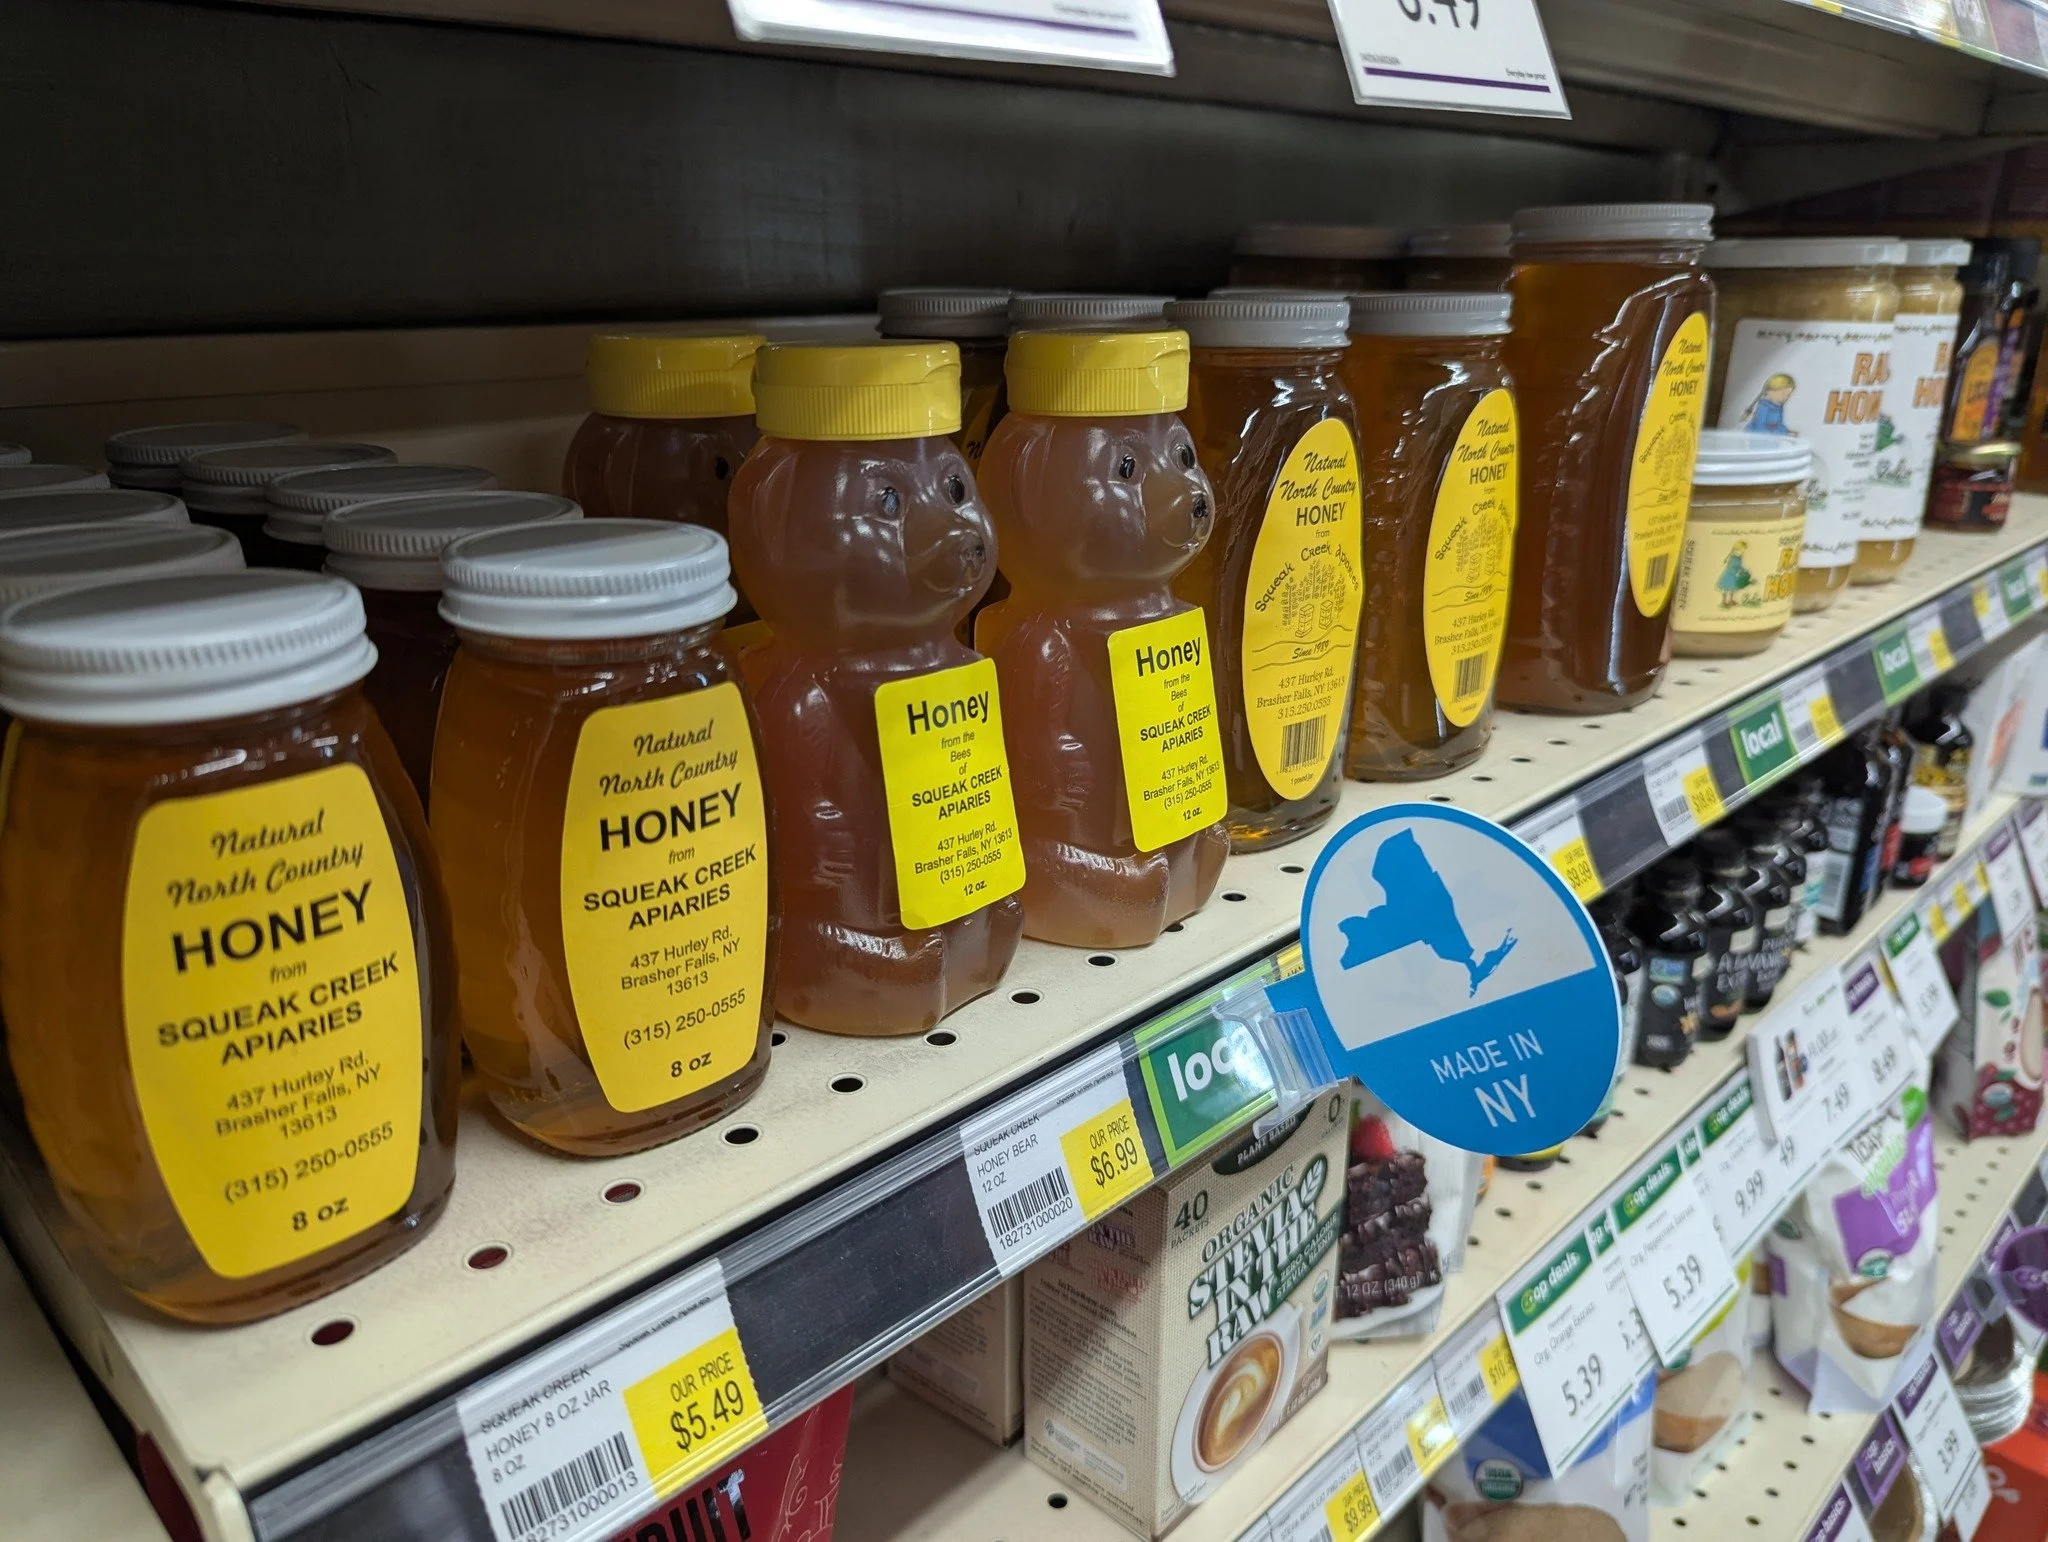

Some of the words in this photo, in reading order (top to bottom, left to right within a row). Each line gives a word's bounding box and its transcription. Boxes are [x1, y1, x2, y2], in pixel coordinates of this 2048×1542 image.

[1669, 380, 1699, 397] HONEY
[1476, 418, 1510, 438] Natural
[1304, 452, 1347, 473] Natural
[1457, 443, 1486, 463] North
[1279, 478, 1319, 502] North
[1322, 476, 1356, 501] Country
[1469, 462, 1508, 485] HONEY
[1296, 502, 1346, 527] HONEY
[1434, 516, 1467, 561] Squeak
[1472, 497, 1496, 516] Creek
[1316, 529, 1330, 538] from
[1255, 561, 1295, 612] Squeak
[1301, 540, 1332, 562] Creek
[1136, 637, 1201, 677] Honey
[1292, 648, 1312, 659] Since
[1434, 632, 1462, 646] Brasher
[1881, 636, 1910, 680] local
[1163, 677, 1180, 689] from
[1181, 672, 1191, 684] the
[1171, 688, 1188, 701] Bees
[1256, 694, 1292, 708] Brasher
[1294, 688, 1312, 700] Falls,
[1314, 683, 1326, 696] NY
[1279, 676, 1296, 689] 437
[1298, 670, 1323, 684] Hurley
[906, 690, 989, 735] Honey
[1140, 716, 1185, 741] SQUEAK
[1187, 704, 1212, 726] CREEK
[1178, 702, 1185, 713] of
[633, 719, 713, 757] Natural
[941, 737, 961, 749] from
[962, 730, 975, 743] the
[1162, 726, 1204, 753] APIARIES
[1740, 713, 1783, 760] local
[599, 770, 665, 797] North
[670, 749, 739, 789] Country
[950, 748, 971, 763] Bees
[958, 762, 967, 775] of
[1161, 768, 1176, 781] 437
[1178, 759, 1198, 777] Hurley
[1199, 754, 1209, 768] Rd.
[912, 779, 968, 808] SQUEAK
[970, 764, 1003, 790] CREEK
[1143, 783, 1175, 801] Brasher
[1177, 773, 1195, 790] Falls,
[1196, 768, 1206, 782] NY
[1163, 792, 1184, 810] (315)
[600, 783, 743, 852] HONEY
[938, 790, 991, 820] APIARIES
[1183, 809, 1191, 821] 12
[1192, 805, 1202, 817] oz.
[210, 808, 326, 858] Natural
[937, 837, 954, 851] 437
[957, 827, 984, 847] Hurley
[984, 820, 997, 835] Rd.
[668, 845, 695, 866] from
[915, 854, 954, 875] Brasher
[956, 843, 979, 862] Falls,
[980, 837, 992, 852] NY
[940, 865, 965, 884] (315)
[966, 849, 1002, 874] 250-0555
[166, 872, 257, 908] North
[266, 841, 366, 893] Country
[583, 872, 689, 912] SQUEAK
[694, 844, 758, 887] CREEK
[963, 884, 973, 896] 12
[975, 879, 987, 892] oz.
[628, 883, 731, 931] APIARIES
[171, 879, 373, 974] HONEY
[621, 965, 681, 991] Brasher
[684, 950, 720, 977] Falls,
[723, 937, 742, 960] NY
[630, 951, 659, 970] 437
[664, 935, 710, 964] Hurley
[712, 926, 733, 948] Rd.
[269, 961, 308, 985] from
[666, 971, 709, 996] 13613
[157, 994, 303, 1048] SQUEAK
[309, 952, 401, 1008] CREEK
[220, 1001, 363, 1067] APIARIES
[623, 1019, 671, 1051] (315)
[676, 987, 746, 1033] 250-0555
[670, 1060, 683, 1079] 8
[689, 1051, 713, 1071] oz
[1430, 1040, 1508, 1084] MADE
[1508, 1029, 1544, 1061] IN
[226, 1086, 265, 1113] 437
[271, 1068, 335, 1100] Hurley
[338, 1050, 370, 1079] Rd.
[215, 1103, 298, 1138] Brasher
[302, 1083, 353, 1115] Falls,
[356, 1063, 382, 1090] NY
[1474, 1074, 1536, 1128] NY
[280, 1106, 338, 1140] 13613
[974, 1129, 1012, 1155] SQUEAK
[1010, 1113, 1040, 1135] CREEK
[1090, 1129, 1107, 1149] OUR
[1107, 1114, 1130, 1140] PRICE
[223, 1163, 289, 1205] (315)
[295, 1122, 394, 1182] 250-0555
[976, 1148, 1012, 1177] HONEY
[1012, 1133, 1039, 1157] BEAR
[1090, 1137, 1137, 1189] $6.99
[982, 1180, 993, 1193] 12
[994, 1171, 1007, 1187] OZ
[1646, 1162, 1673, 1193] deals
[292, 1209, 308, 1233] 8
[317, 1196, 350, 1225] oz
[999, 1197, 1073, 1250] 182731000020
[1174, 1190, 1208, 1230] 40
[1202, 1163, 1295, 1263] ORGANIC
[1171, 1219, 1209, 1249] PACKETS
[1188, 1186, 1304, 1320] STEVIA
[1549, 1251, 1580, 1284] deals
[1346, 1284, 1358, 1297] 12
[1663, 1254, 1701, 1310] 5.39
[1206, 1273, 1278, 1370] RAW
[670, 1372, 698, 1403] OUR
[698, 1351, 734, 1385] PRICE
[1561, 1353, 1602, 1416] 5.39
[480, 1394, 542, 1433] SQUEAK
[543, 1364, 591, 1399] CREEK
[669, 1379, 746, 1454] $5.49
[485, 1418, 541, 1463] HONEY
[545, 1411, 555, 1428] 8
[557, 1397, 581, 1420] OZ
[583, 1379, 612, 1407] JAR
[492, 1468, 503, 1483] 8
[504, 1455, 526, 1476] OZ
[1343, 1493, 1373, 1534] $9.99
